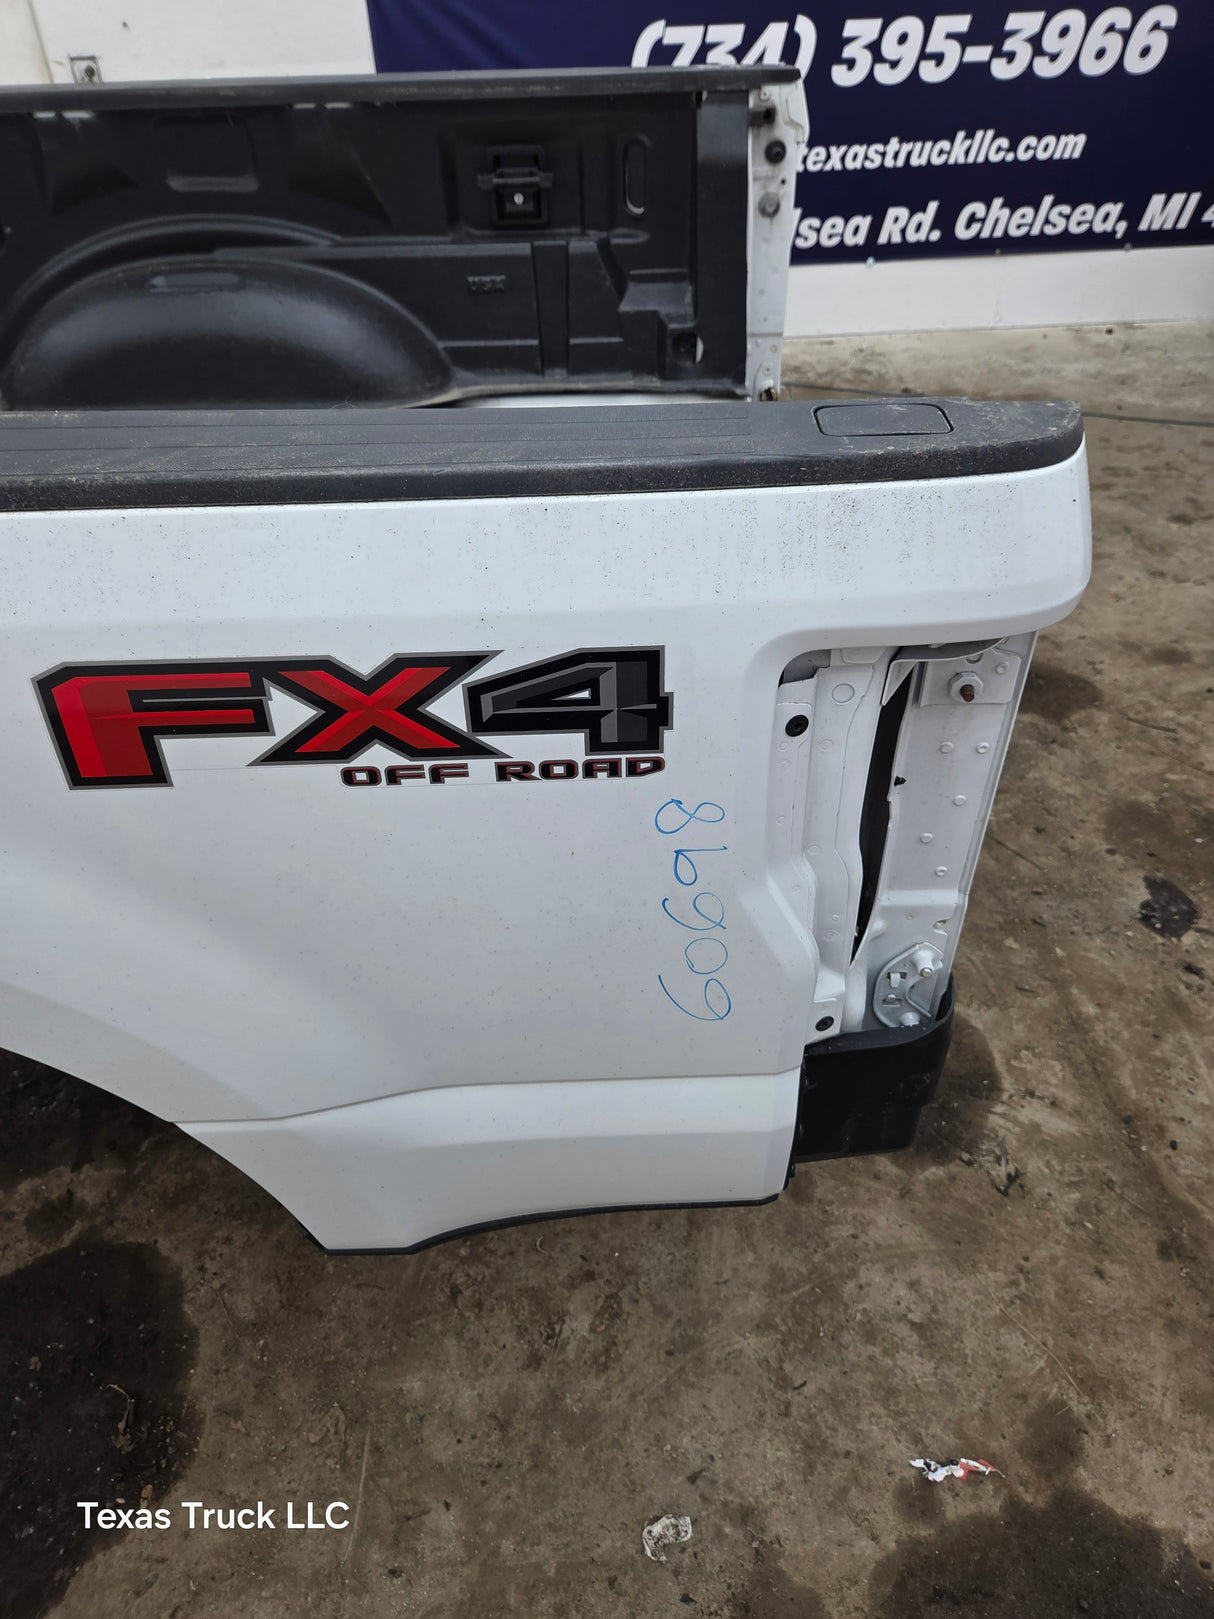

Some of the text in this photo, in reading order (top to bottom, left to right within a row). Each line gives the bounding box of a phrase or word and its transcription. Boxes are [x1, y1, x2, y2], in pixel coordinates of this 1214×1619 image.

[631, 5, 1178, 87] (734) 395-3966
[877, 202, 942, 245] Rd.
[954, 195, 1128, 241] Chelsea,
[1138, 191, 1202, 231] MI
[31, 645, 674, 790] FX4
[341, 756, 666, 787] OFF ROAD
[655, 798, 732, 1022] 60698
